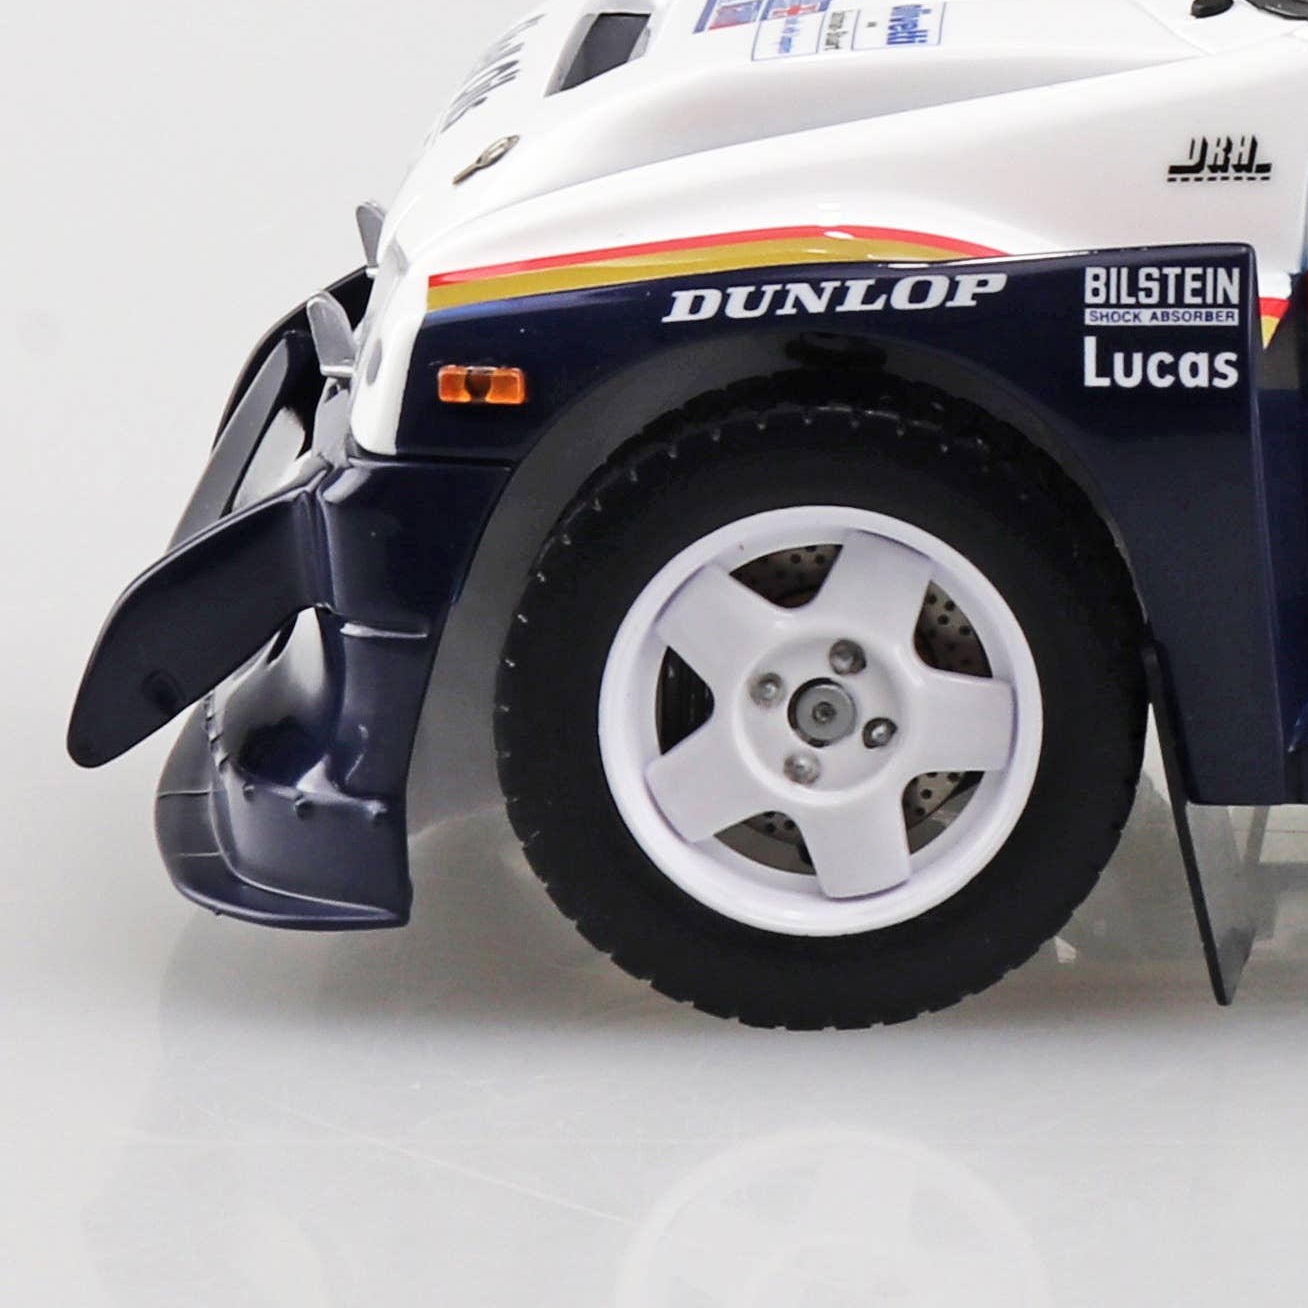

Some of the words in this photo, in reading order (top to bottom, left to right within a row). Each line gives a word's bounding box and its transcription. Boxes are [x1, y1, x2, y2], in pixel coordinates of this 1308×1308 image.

[660, 272, 1008, 324] DUNLOP
[1084, 266, 1240, 305] BILSTEIN
[1089, 310, 1142, 323] SHOCK
[1150, 310, 1235, 323] ABSORBER
[1084, 335, 1239, 389] Lucas
